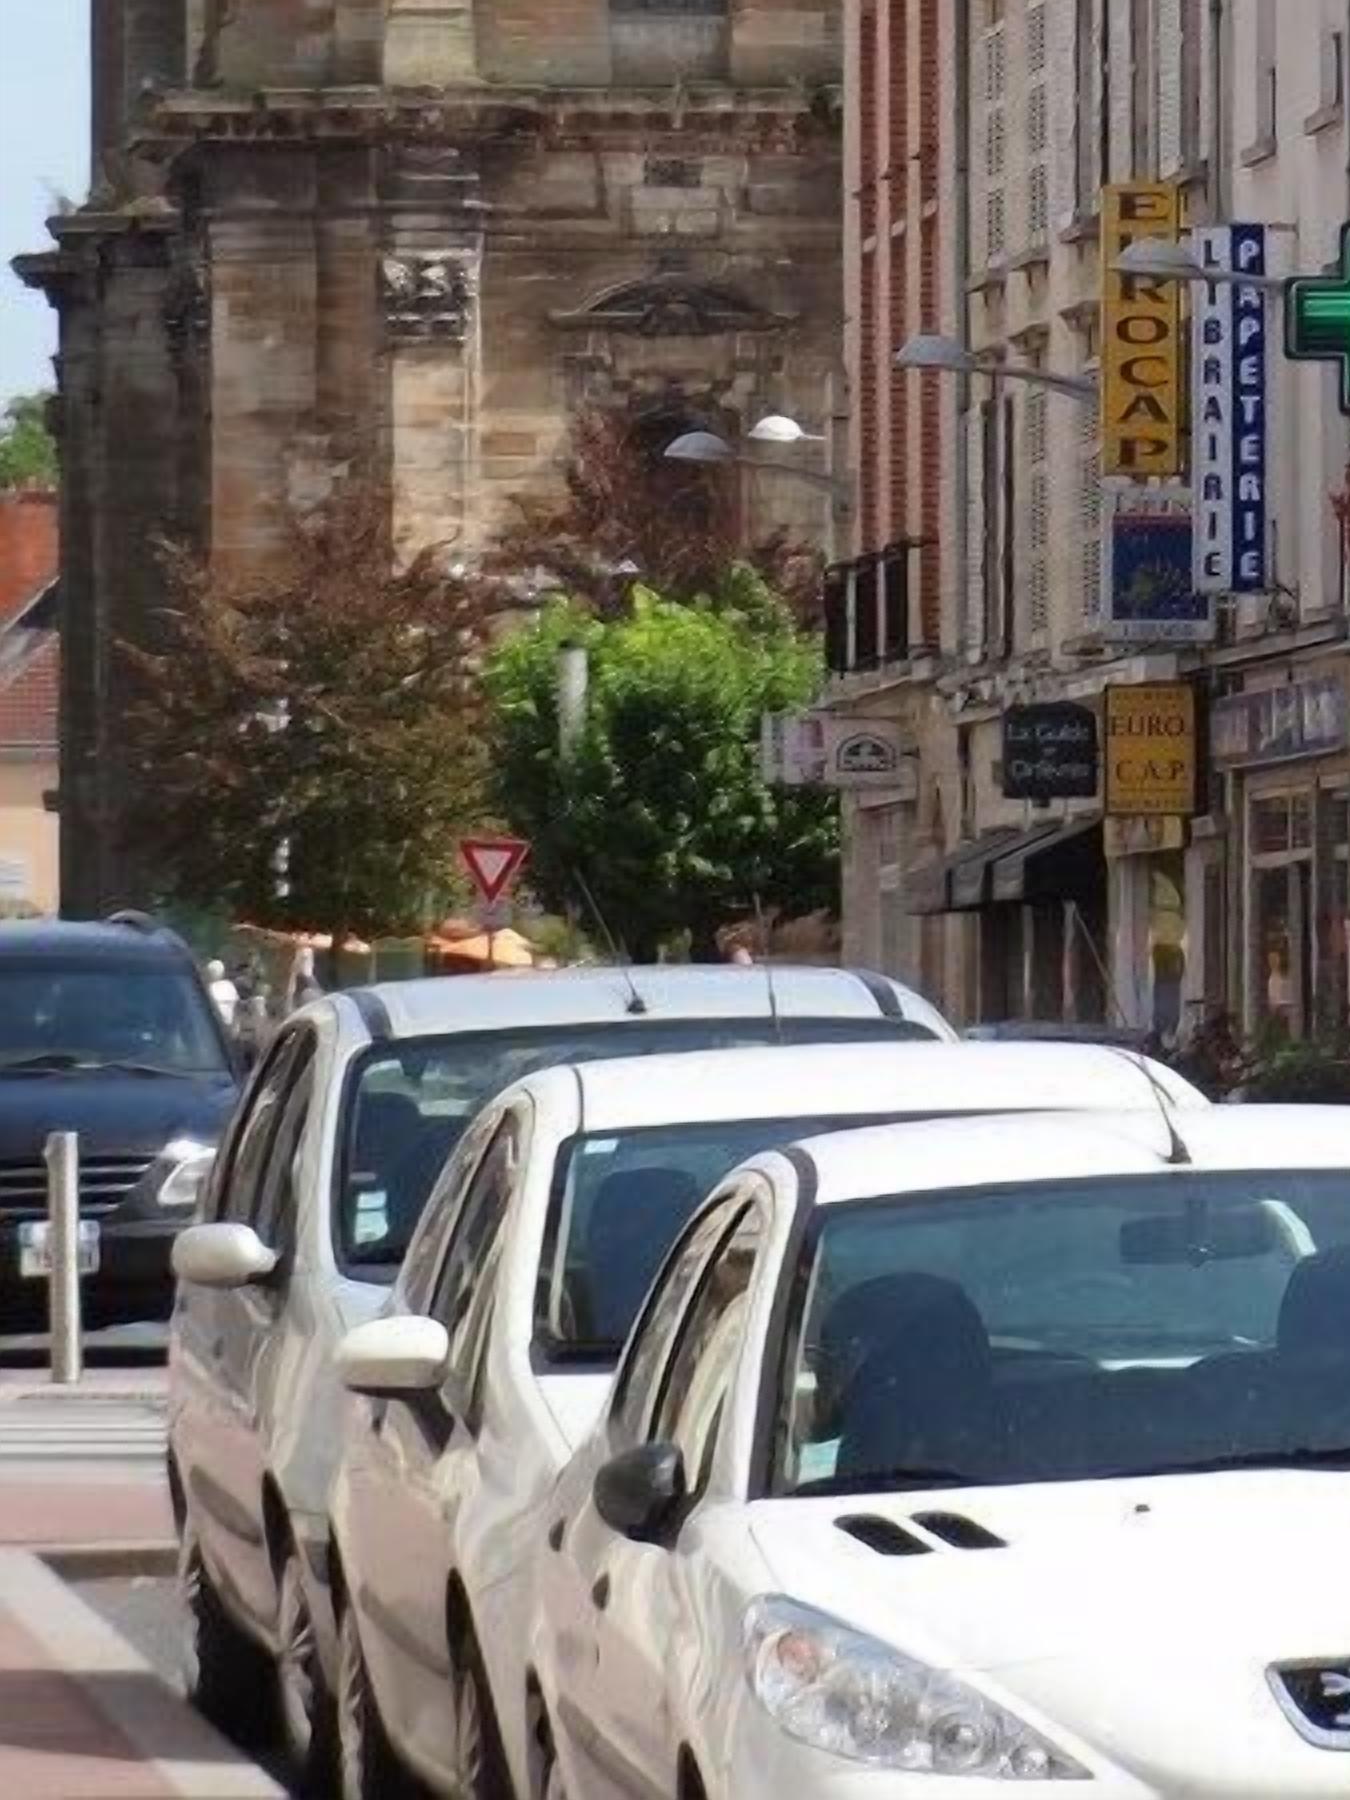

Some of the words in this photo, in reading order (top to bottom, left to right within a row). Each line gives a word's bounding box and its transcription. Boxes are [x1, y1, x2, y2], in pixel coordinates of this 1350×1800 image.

[1117, 192, 1170, 467] EROCAP
[1202, 239, 1224, 578] LIBRAIRIE
[1238, 239, 1261, 578] PAPETERIE
